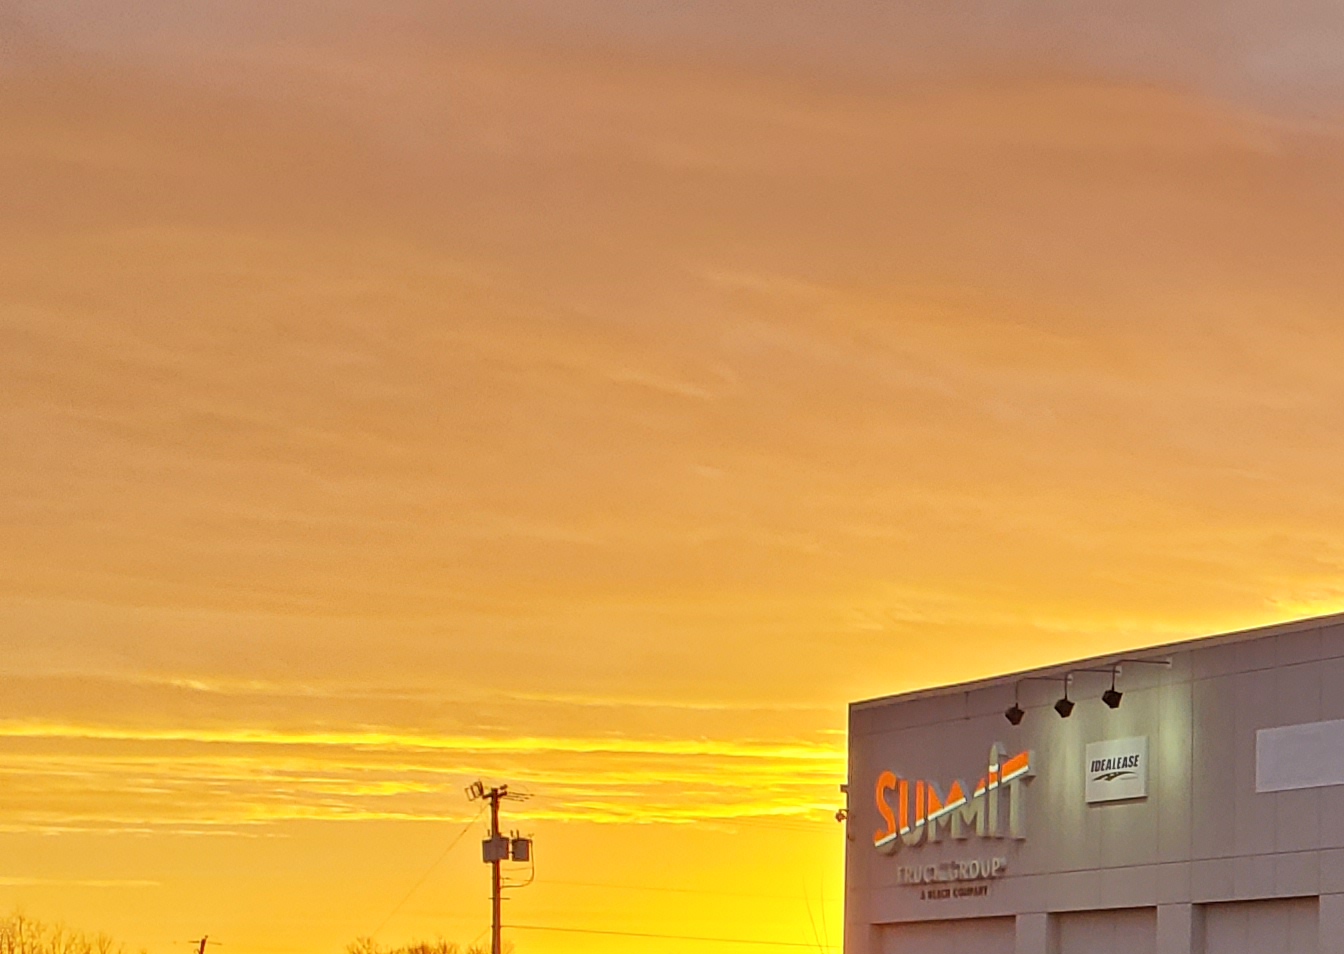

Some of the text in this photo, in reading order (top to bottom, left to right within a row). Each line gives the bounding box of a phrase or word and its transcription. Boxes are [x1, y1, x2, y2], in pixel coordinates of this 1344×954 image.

[1090, 754, 1140, 773] IDEALEASE
[874, 743, 1035, 855] SUMMIT
[949, 857, 1000, 880] GROUP
